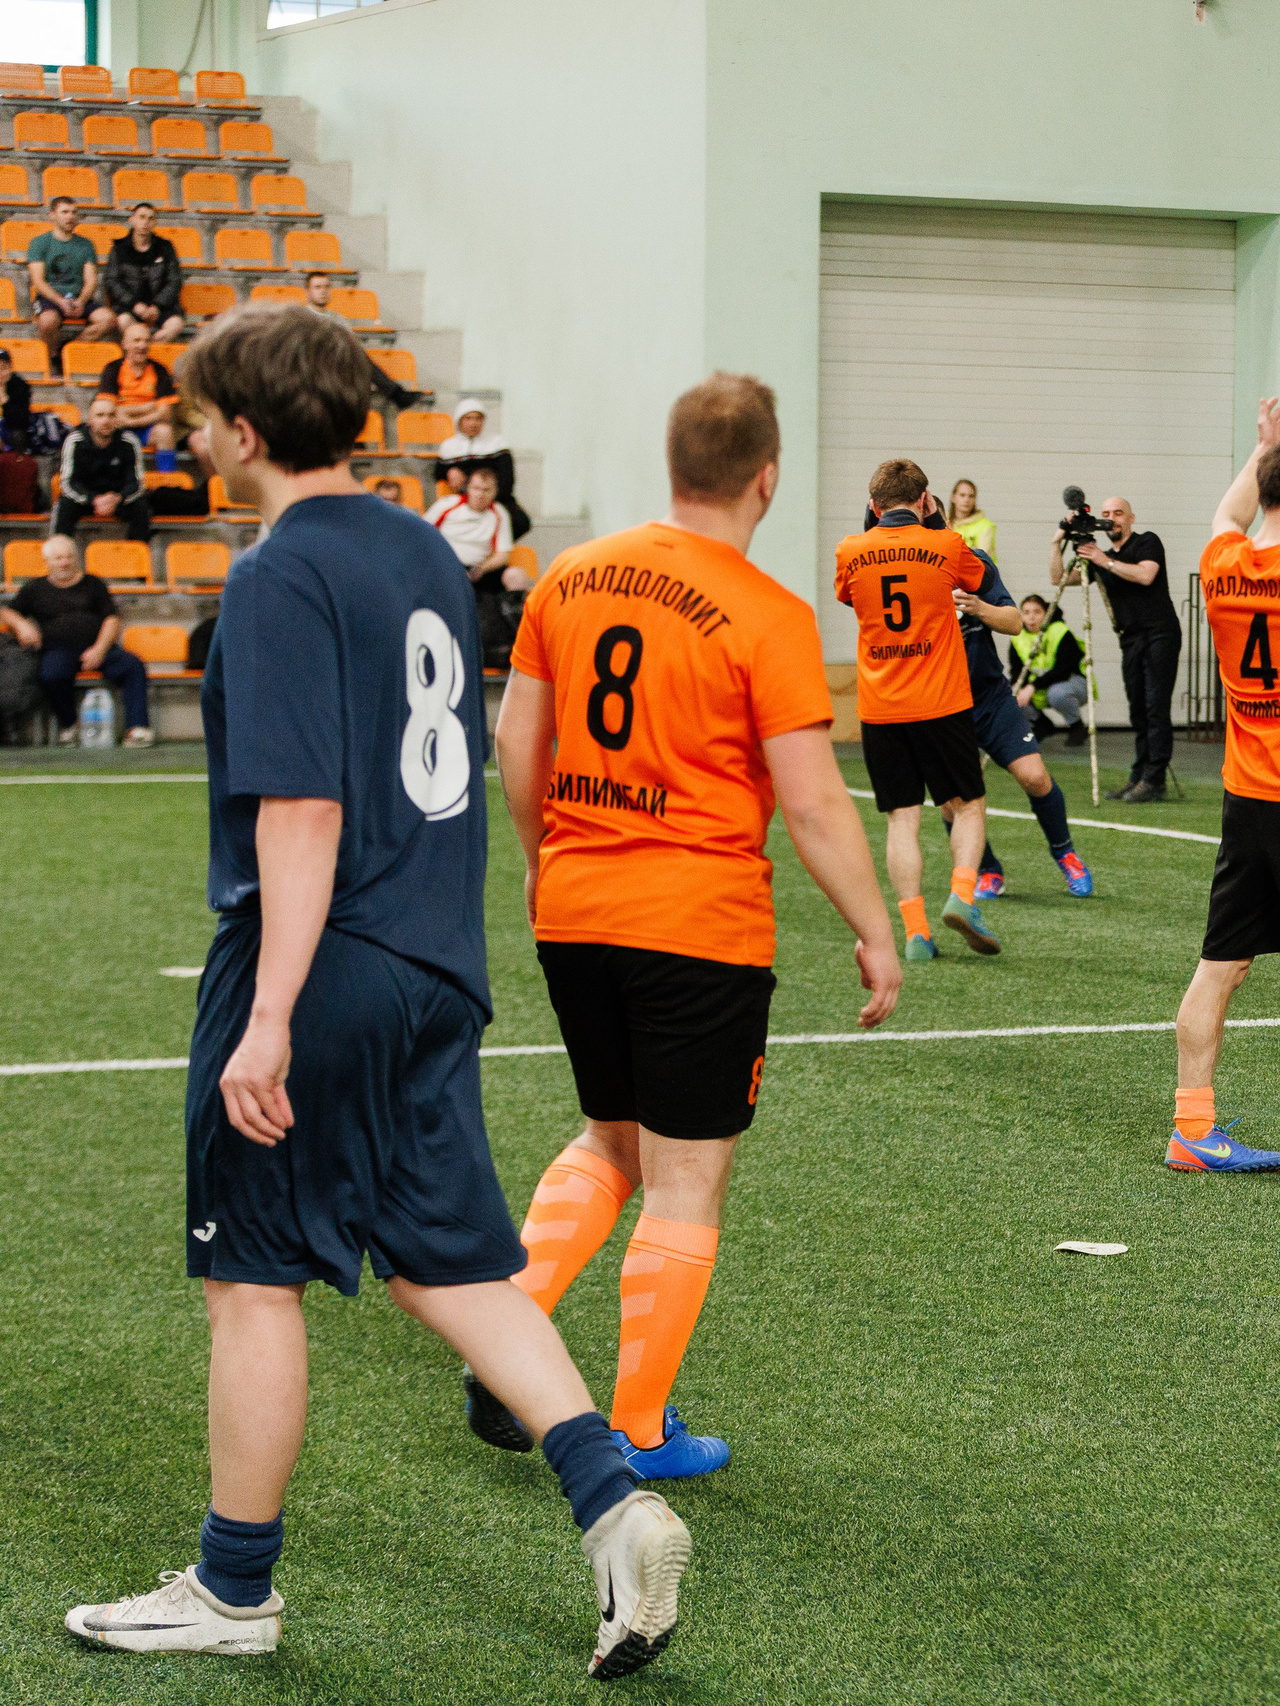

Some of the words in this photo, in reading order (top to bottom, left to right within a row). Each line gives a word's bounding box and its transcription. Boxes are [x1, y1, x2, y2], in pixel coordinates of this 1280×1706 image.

[846, 547, 948, 575] УРАЛДОЛОМИТ
[558, 565, 731, 637] УРАЛДОЛОМИТ
[880, 574, 912, 632] 5
[1240, 612, 1279, 691] 4
[400, 607, 471, 822] 8
[587, 624, 644, 752] 8
[747, 1055, 765, 1106] 8
